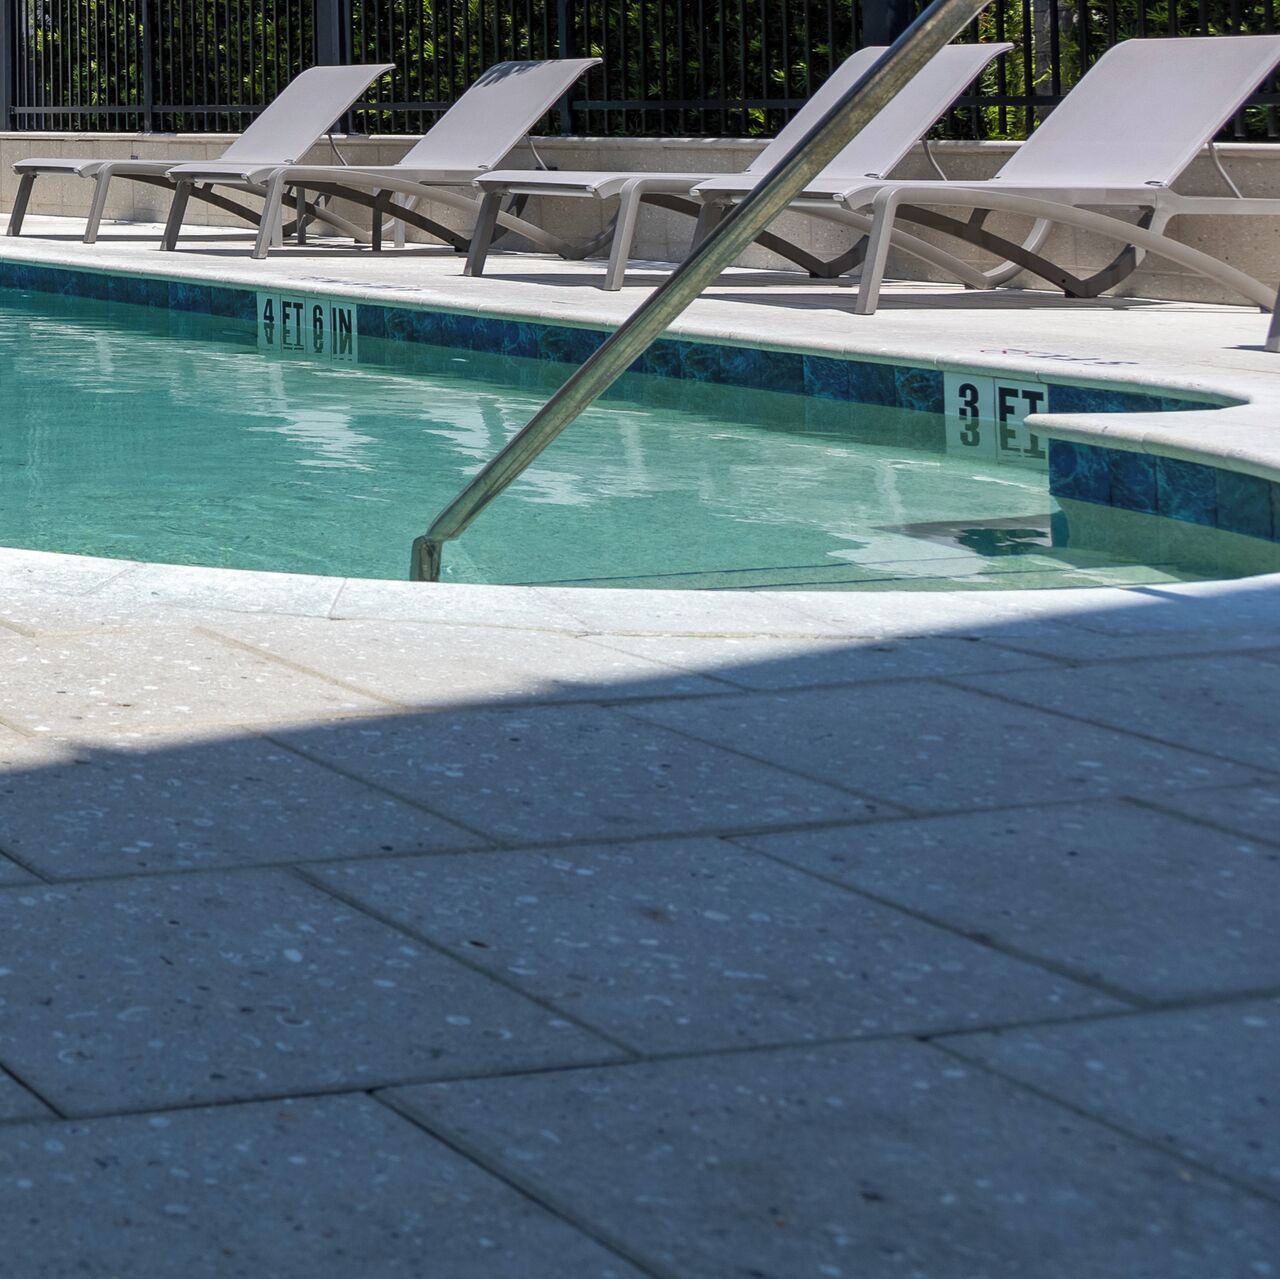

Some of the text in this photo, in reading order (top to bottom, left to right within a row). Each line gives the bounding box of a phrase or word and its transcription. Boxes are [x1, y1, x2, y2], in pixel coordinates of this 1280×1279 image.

[263, 298, 352, 334] 4 FT 6 IN
[958, 383, 1044, 422] 3 FT
